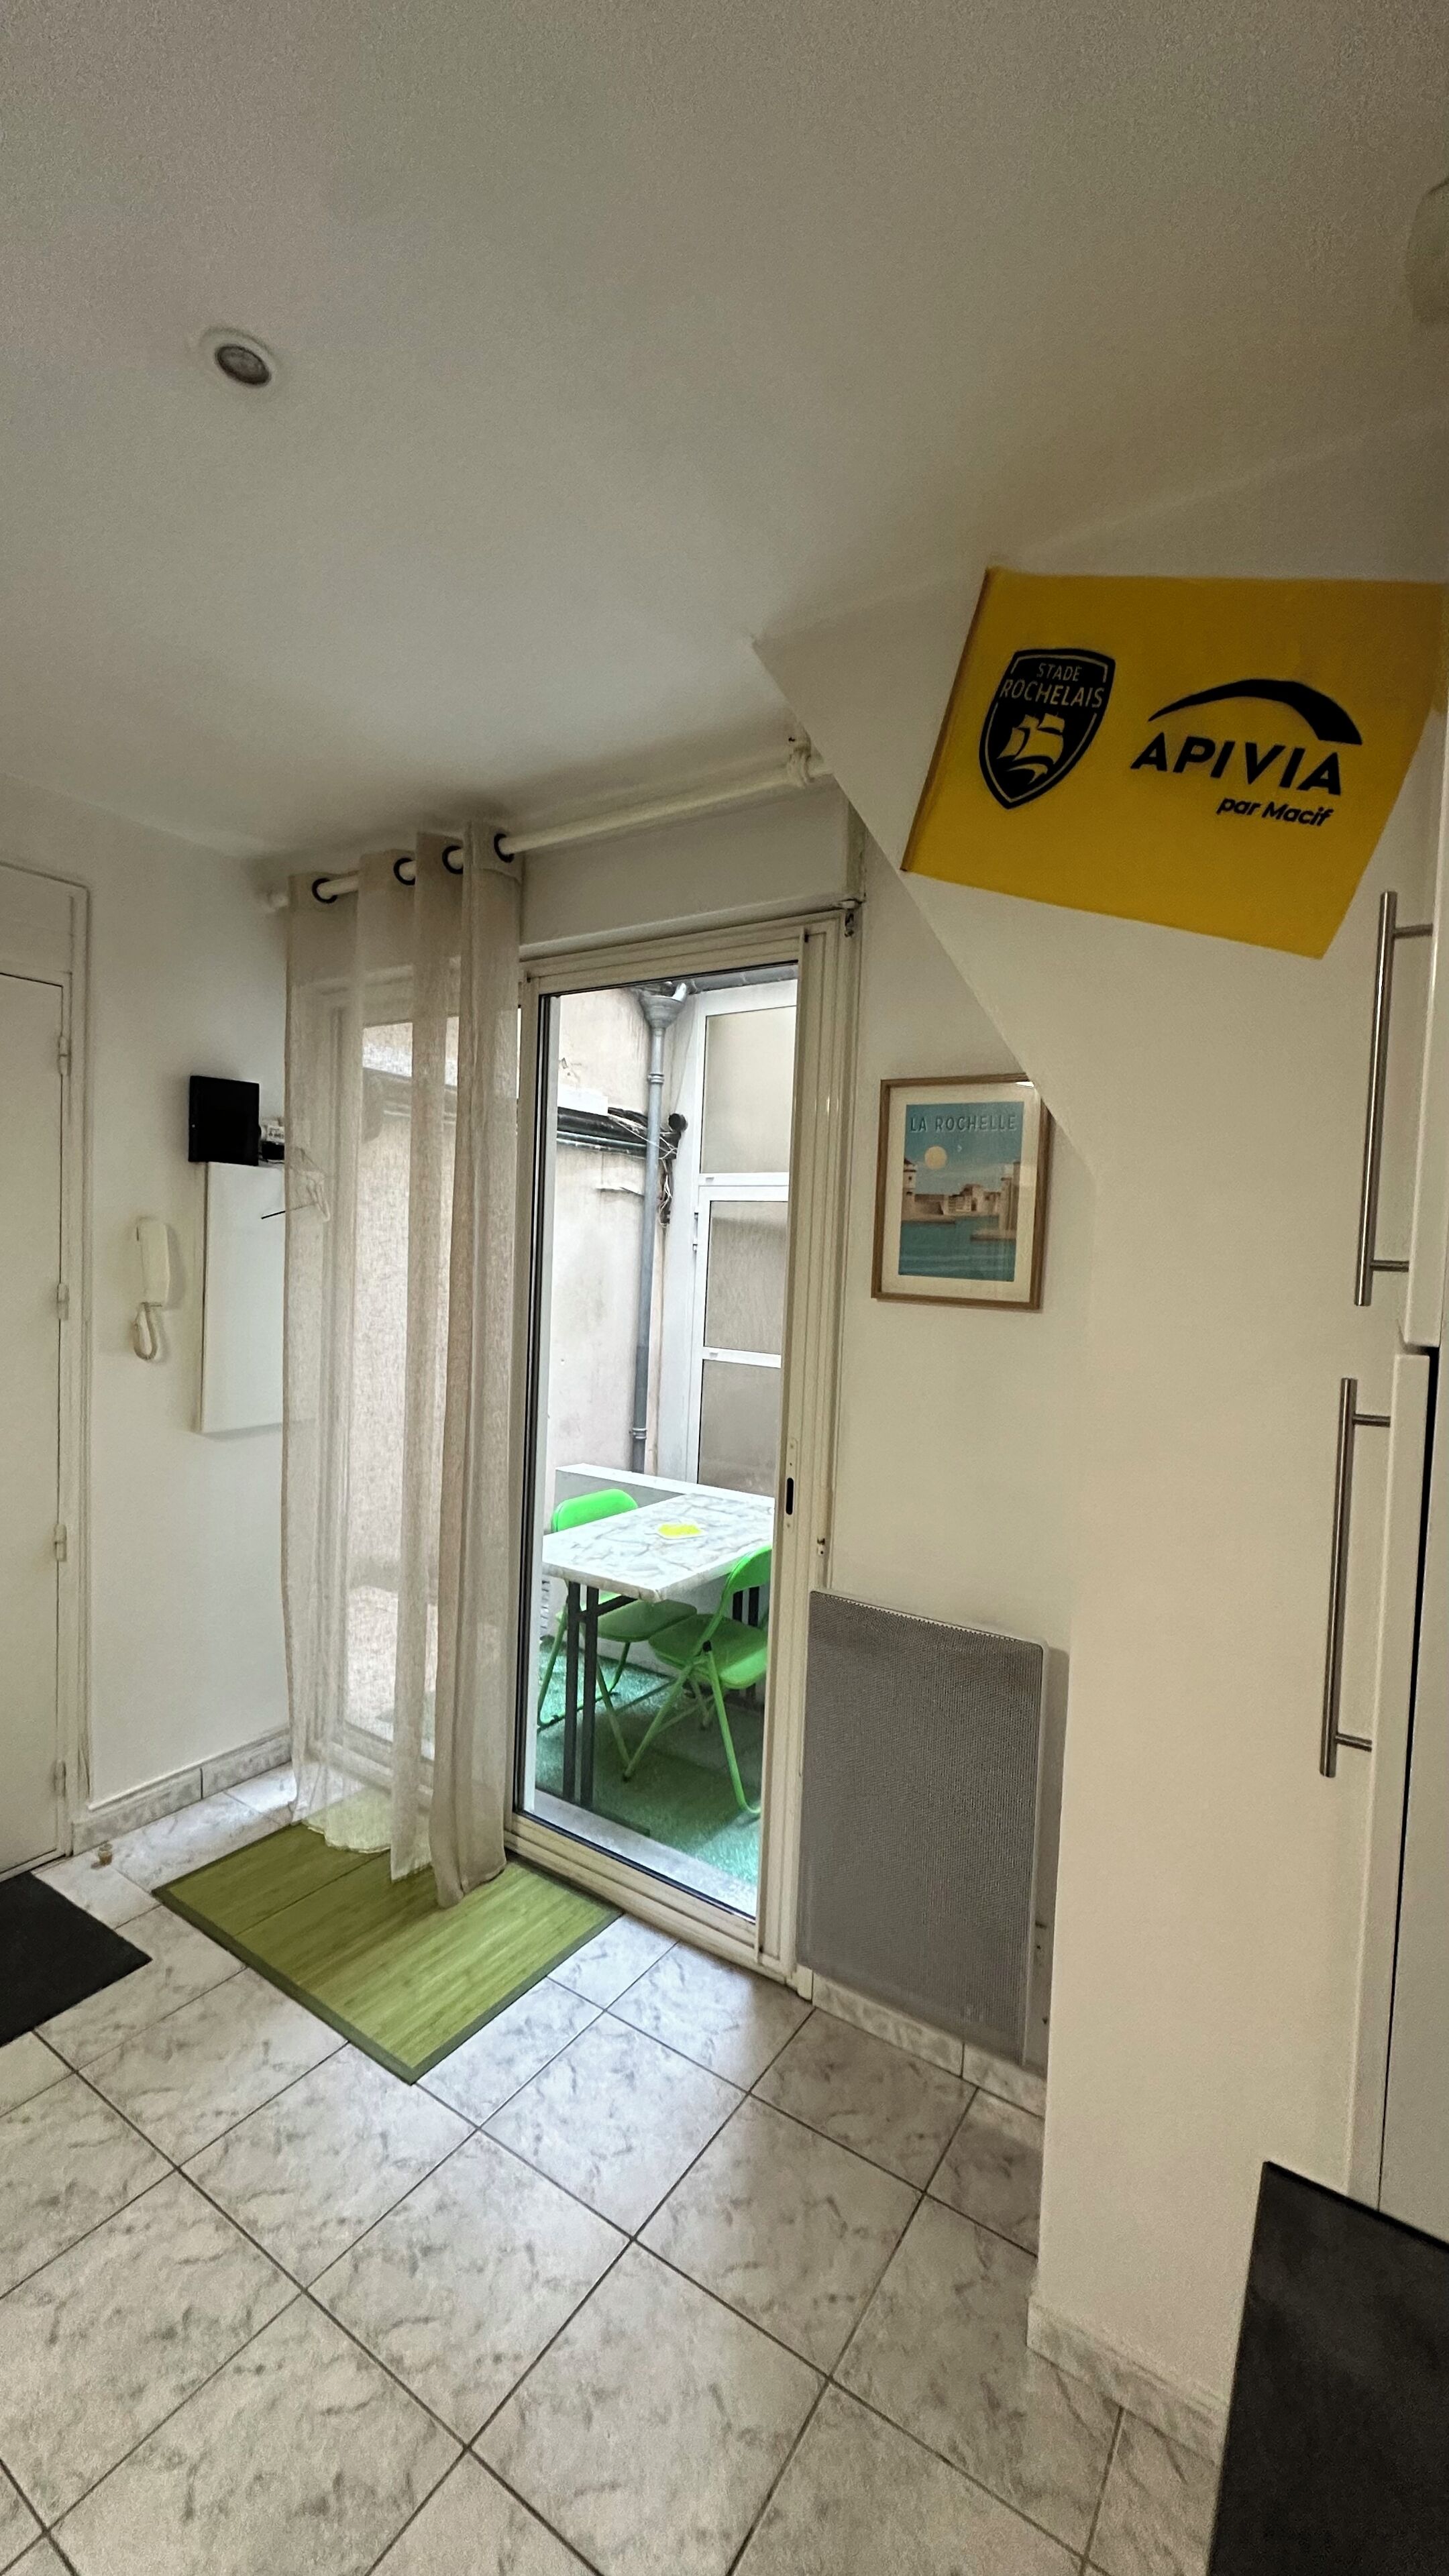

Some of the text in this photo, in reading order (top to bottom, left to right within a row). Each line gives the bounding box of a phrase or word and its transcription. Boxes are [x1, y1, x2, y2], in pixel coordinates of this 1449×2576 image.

[1036, 662, 1083, 682] STADE
[999, 678, 1105, 708] ROCHELAIS
[1130, 732, 1341, 796] APIVIA
[1216, 798, 1334, 826] par Macif
[910, 1114, 1018, 1132] LA ROCHELLE
